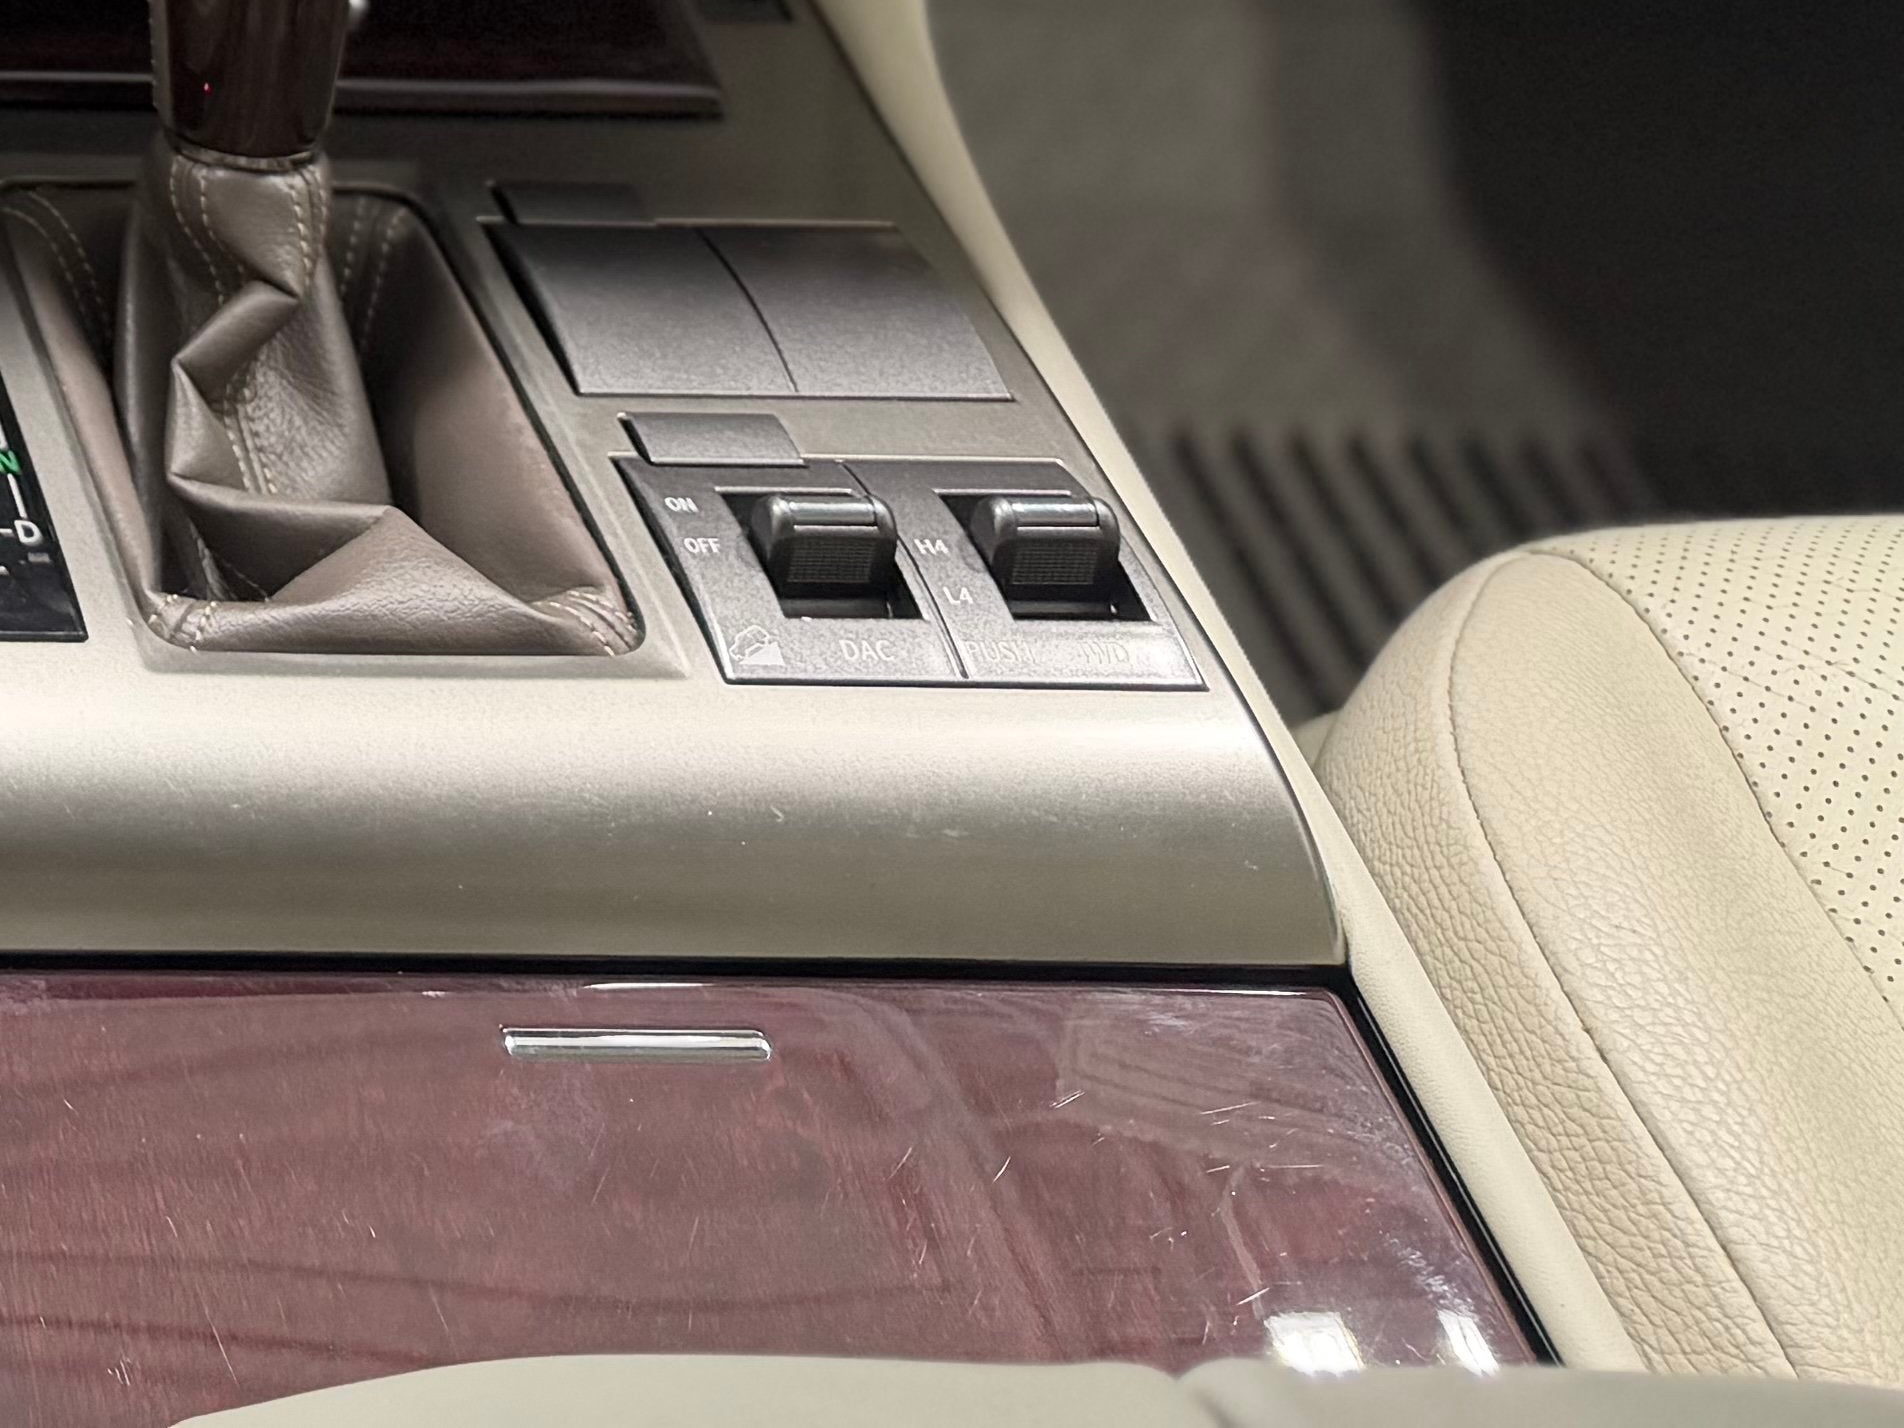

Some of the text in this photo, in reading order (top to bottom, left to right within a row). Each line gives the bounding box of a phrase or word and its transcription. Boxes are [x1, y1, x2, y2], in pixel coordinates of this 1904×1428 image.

[664, 497, 699, 513] ON
[13, 519, 42, 544] D
[683, 537, 721, 554] OFF
[913, 538, 949, 556] H4
[943, 586, 974, 606] L4
[841, 640, 894, 662] DAC
